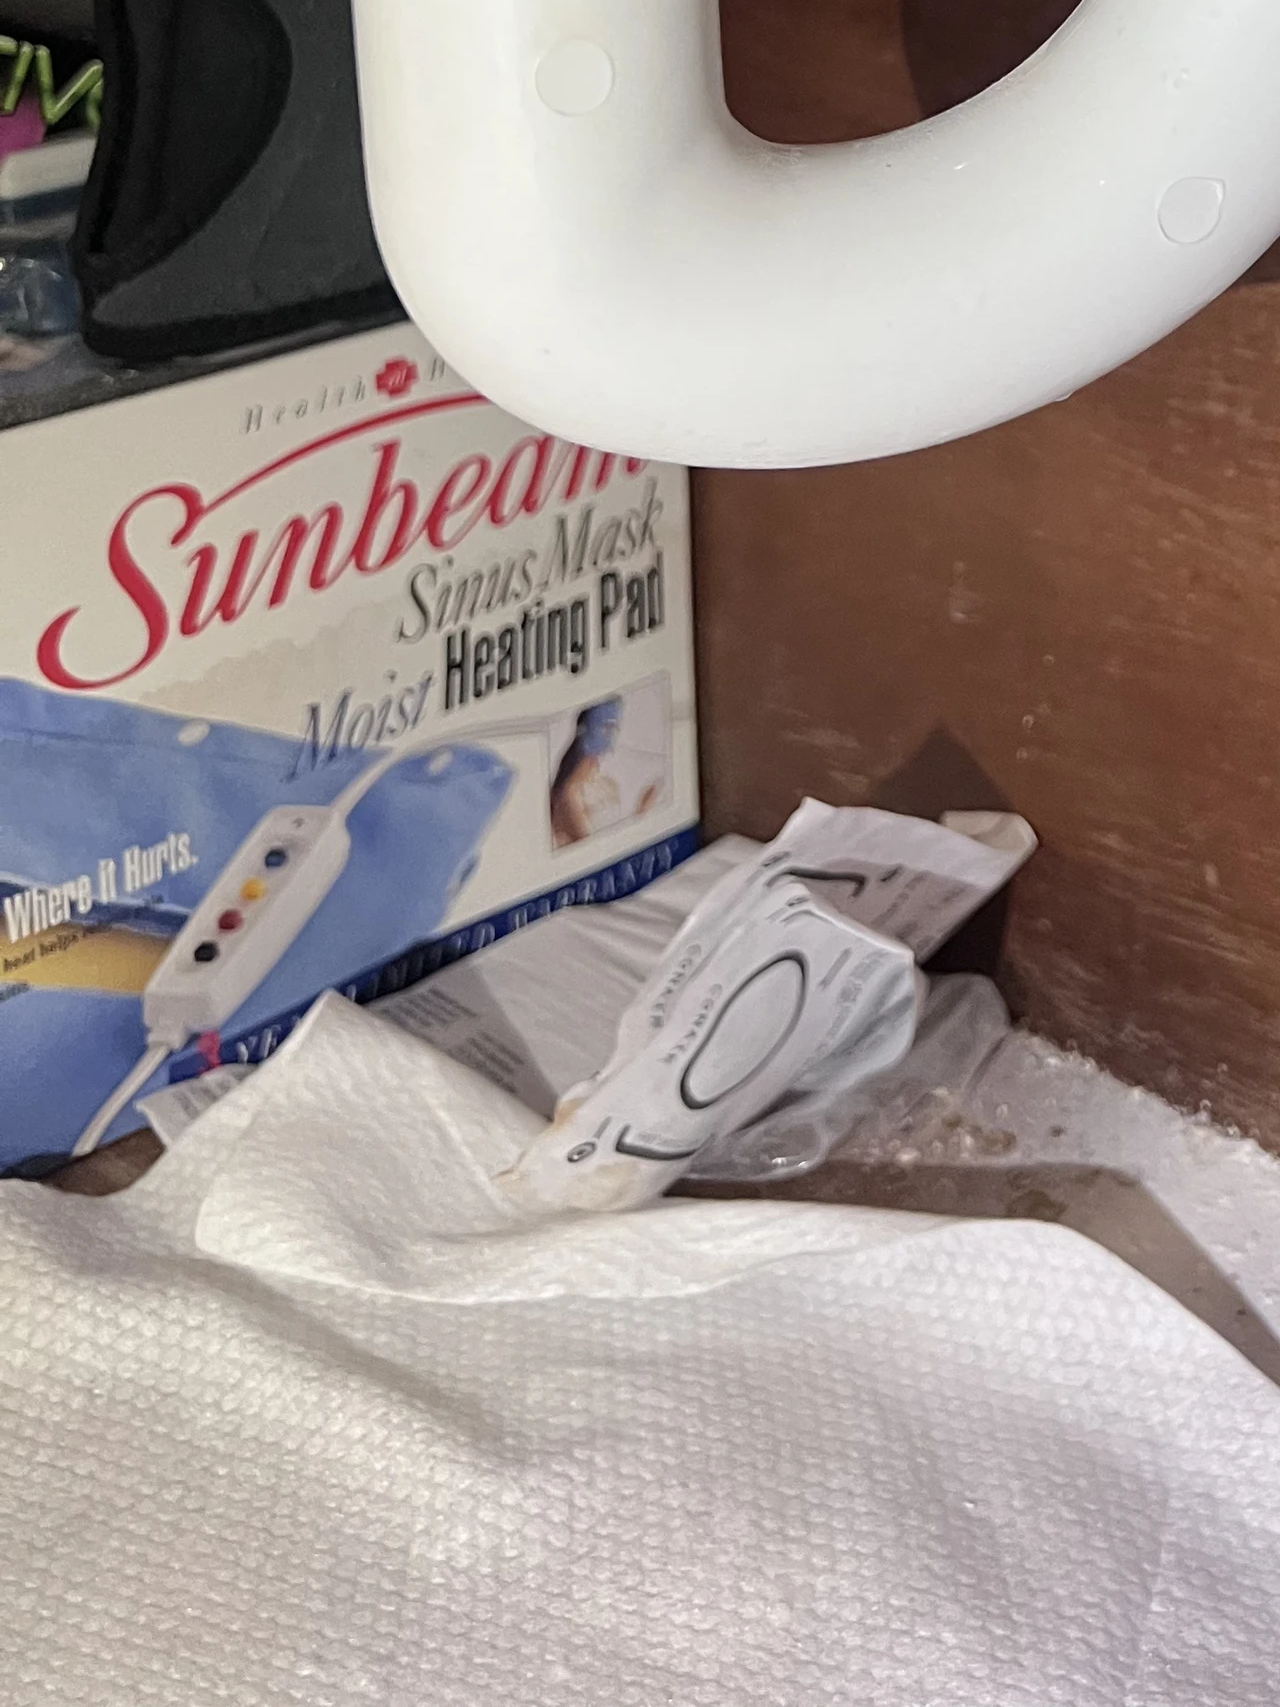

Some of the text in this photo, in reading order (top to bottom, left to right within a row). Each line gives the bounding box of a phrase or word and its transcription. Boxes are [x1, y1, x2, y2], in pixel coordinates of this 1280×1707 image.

[397, 474, 667, 646] Sinus Mask
[284, 548, 665, 784] Moist Heating Pad
[4, 874, 93, 944] Where
[123, 832, 199, 893] Hurts.
